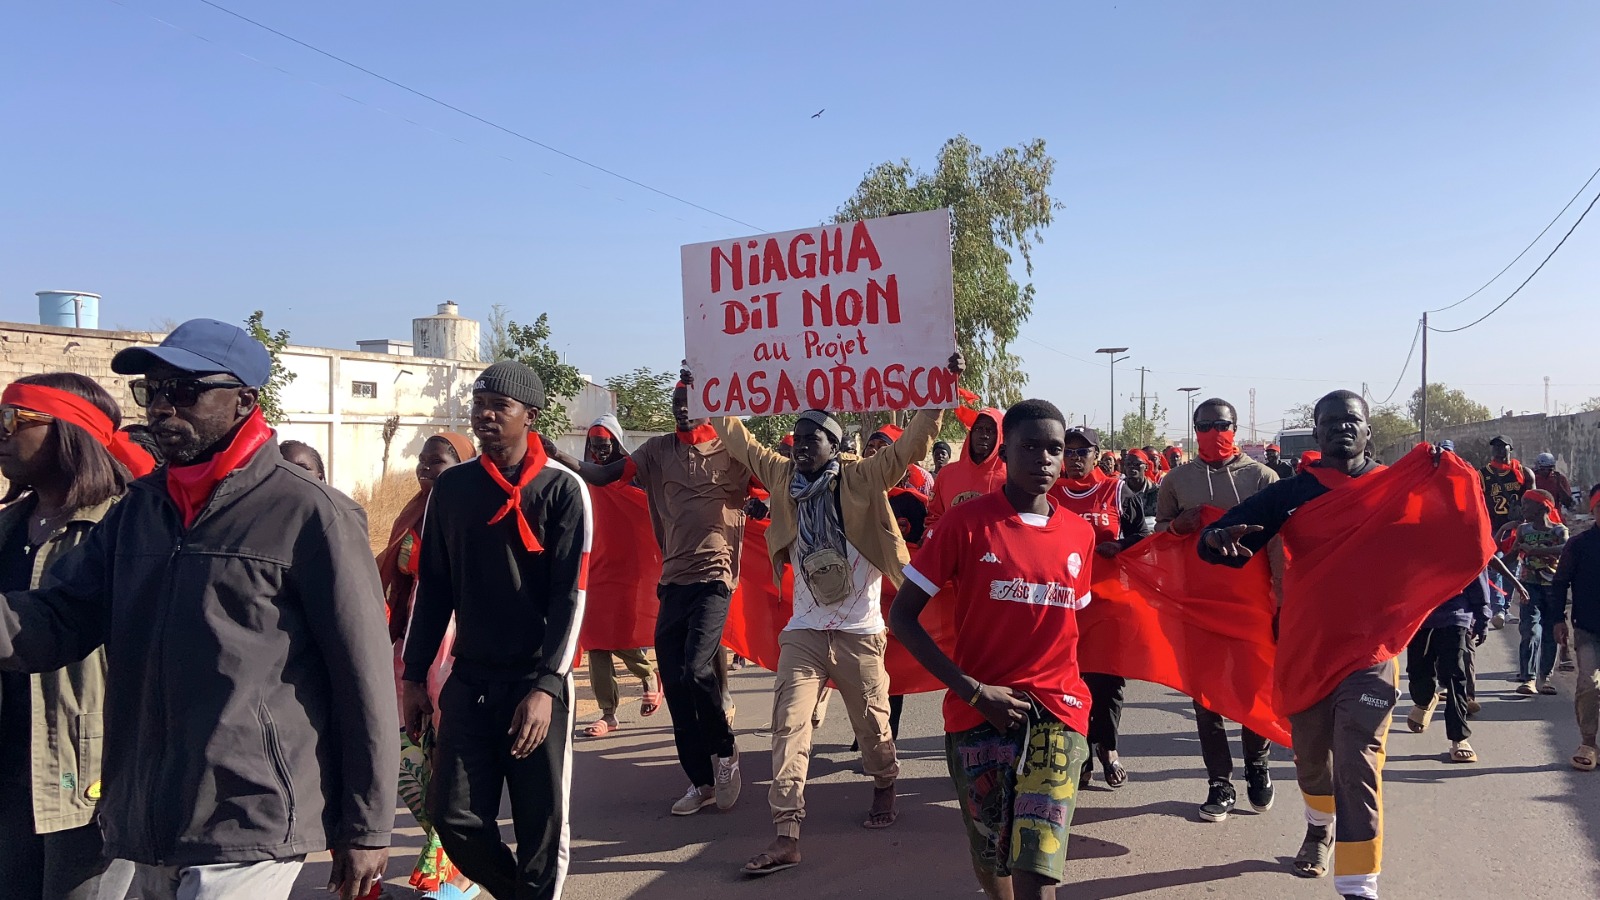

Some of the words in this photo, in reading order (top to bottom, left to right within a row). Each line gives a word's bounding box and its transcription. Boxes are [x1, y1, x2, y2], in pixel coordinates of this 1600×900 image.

[801, 274, 901, 327] NON
[753, 342, 791, 362] au
[804, 329, 869, 365] Projet
